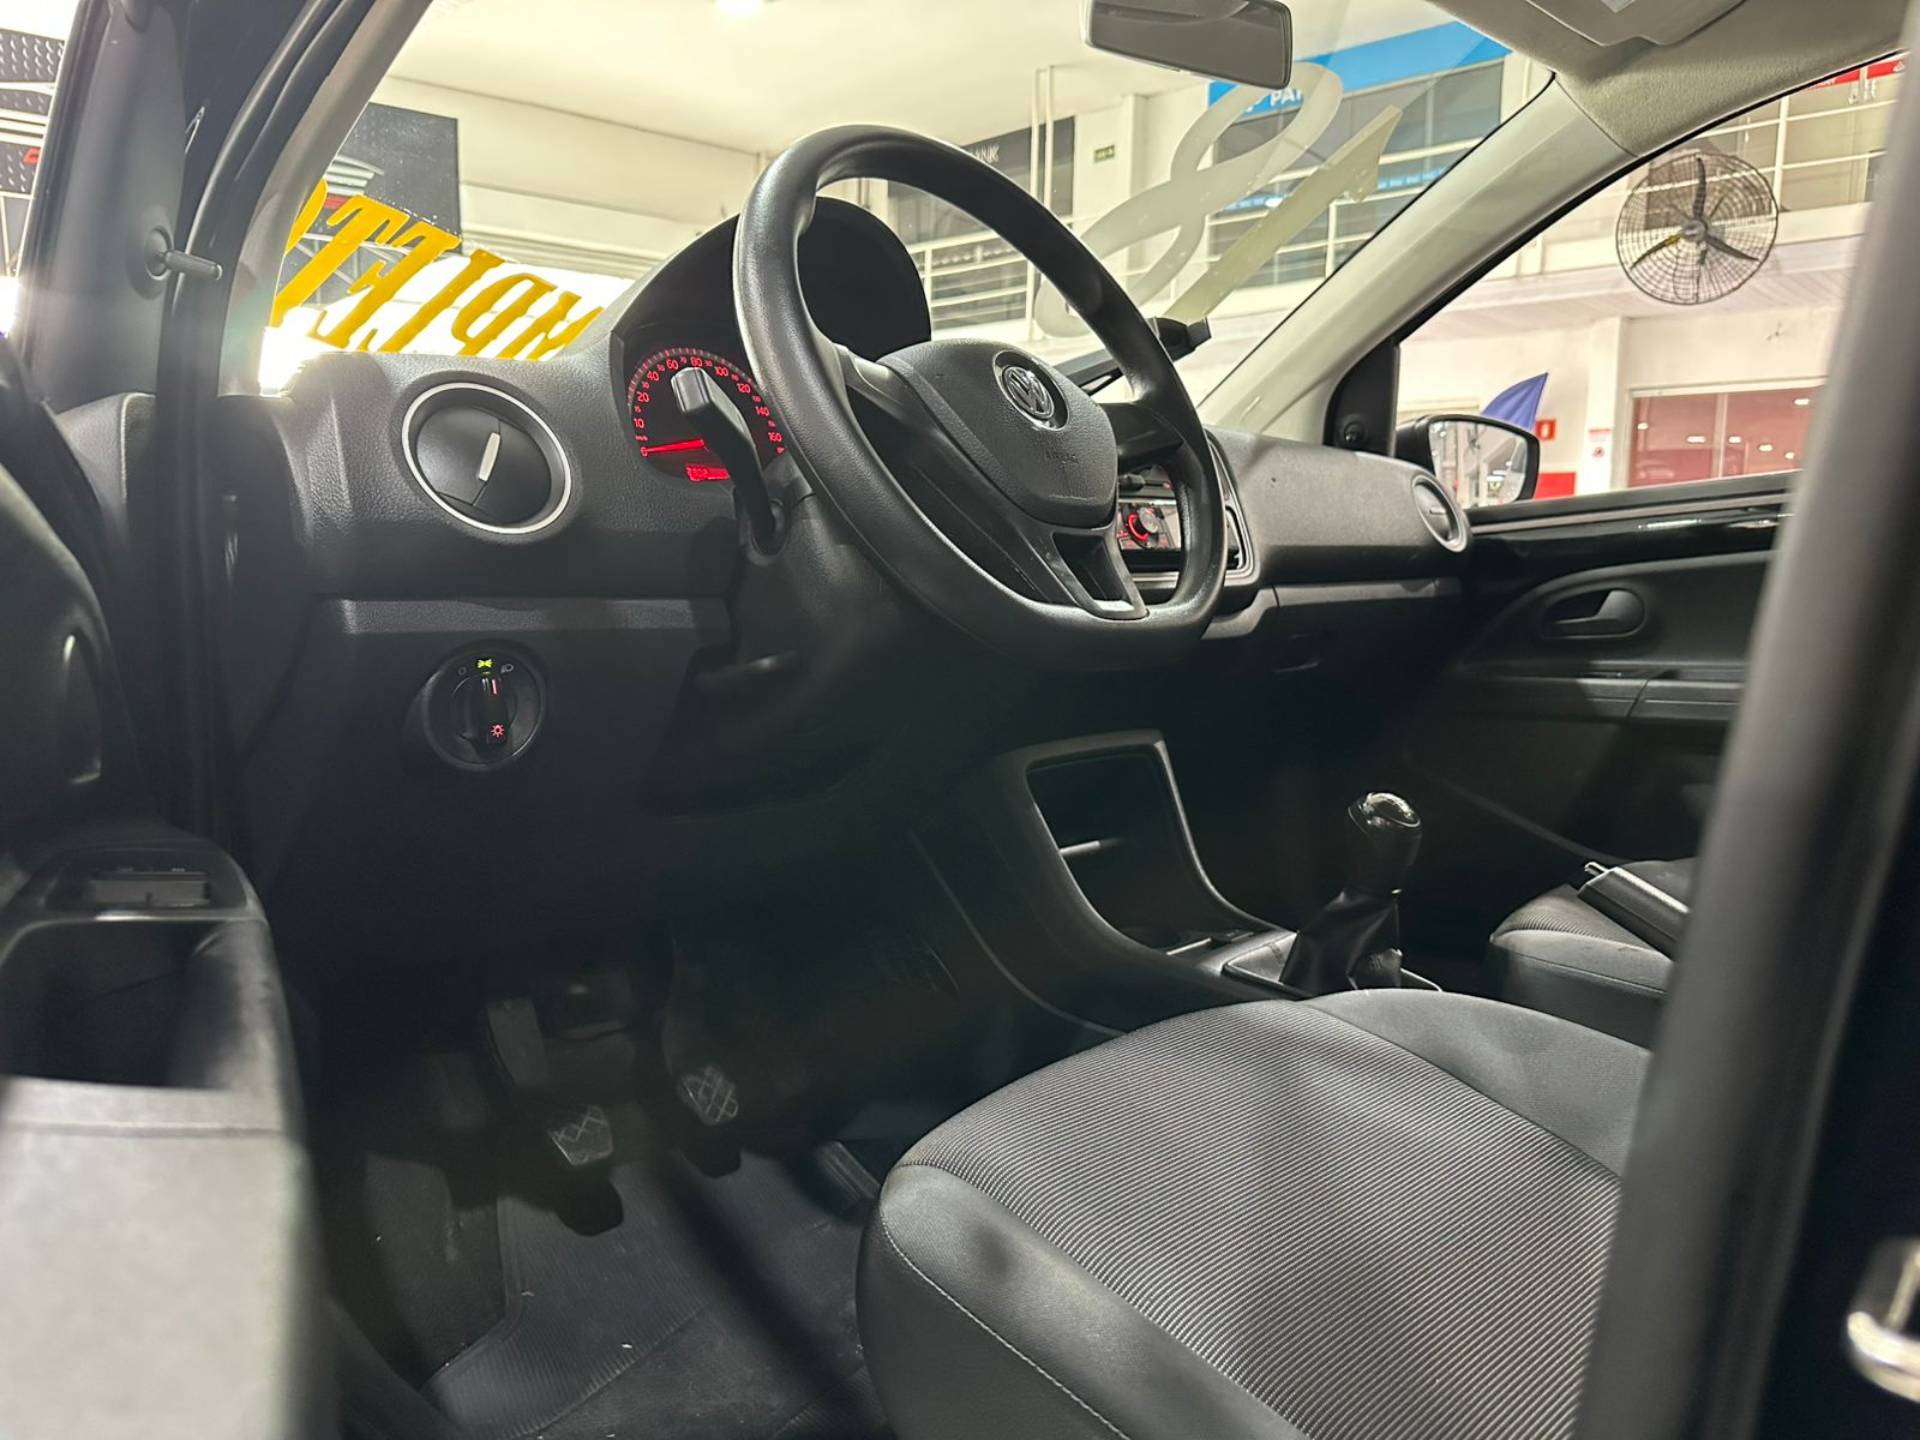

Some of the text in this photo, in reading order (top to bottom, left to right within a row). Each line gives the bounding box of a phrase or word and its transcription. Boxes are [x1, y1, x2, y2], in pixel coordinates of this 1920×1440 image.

[666, 358, 679, 370] 60
[647, 370, 660, 382] 40
[636, 391, 650, 403] 20
[633, 417, 645, 429] 10
